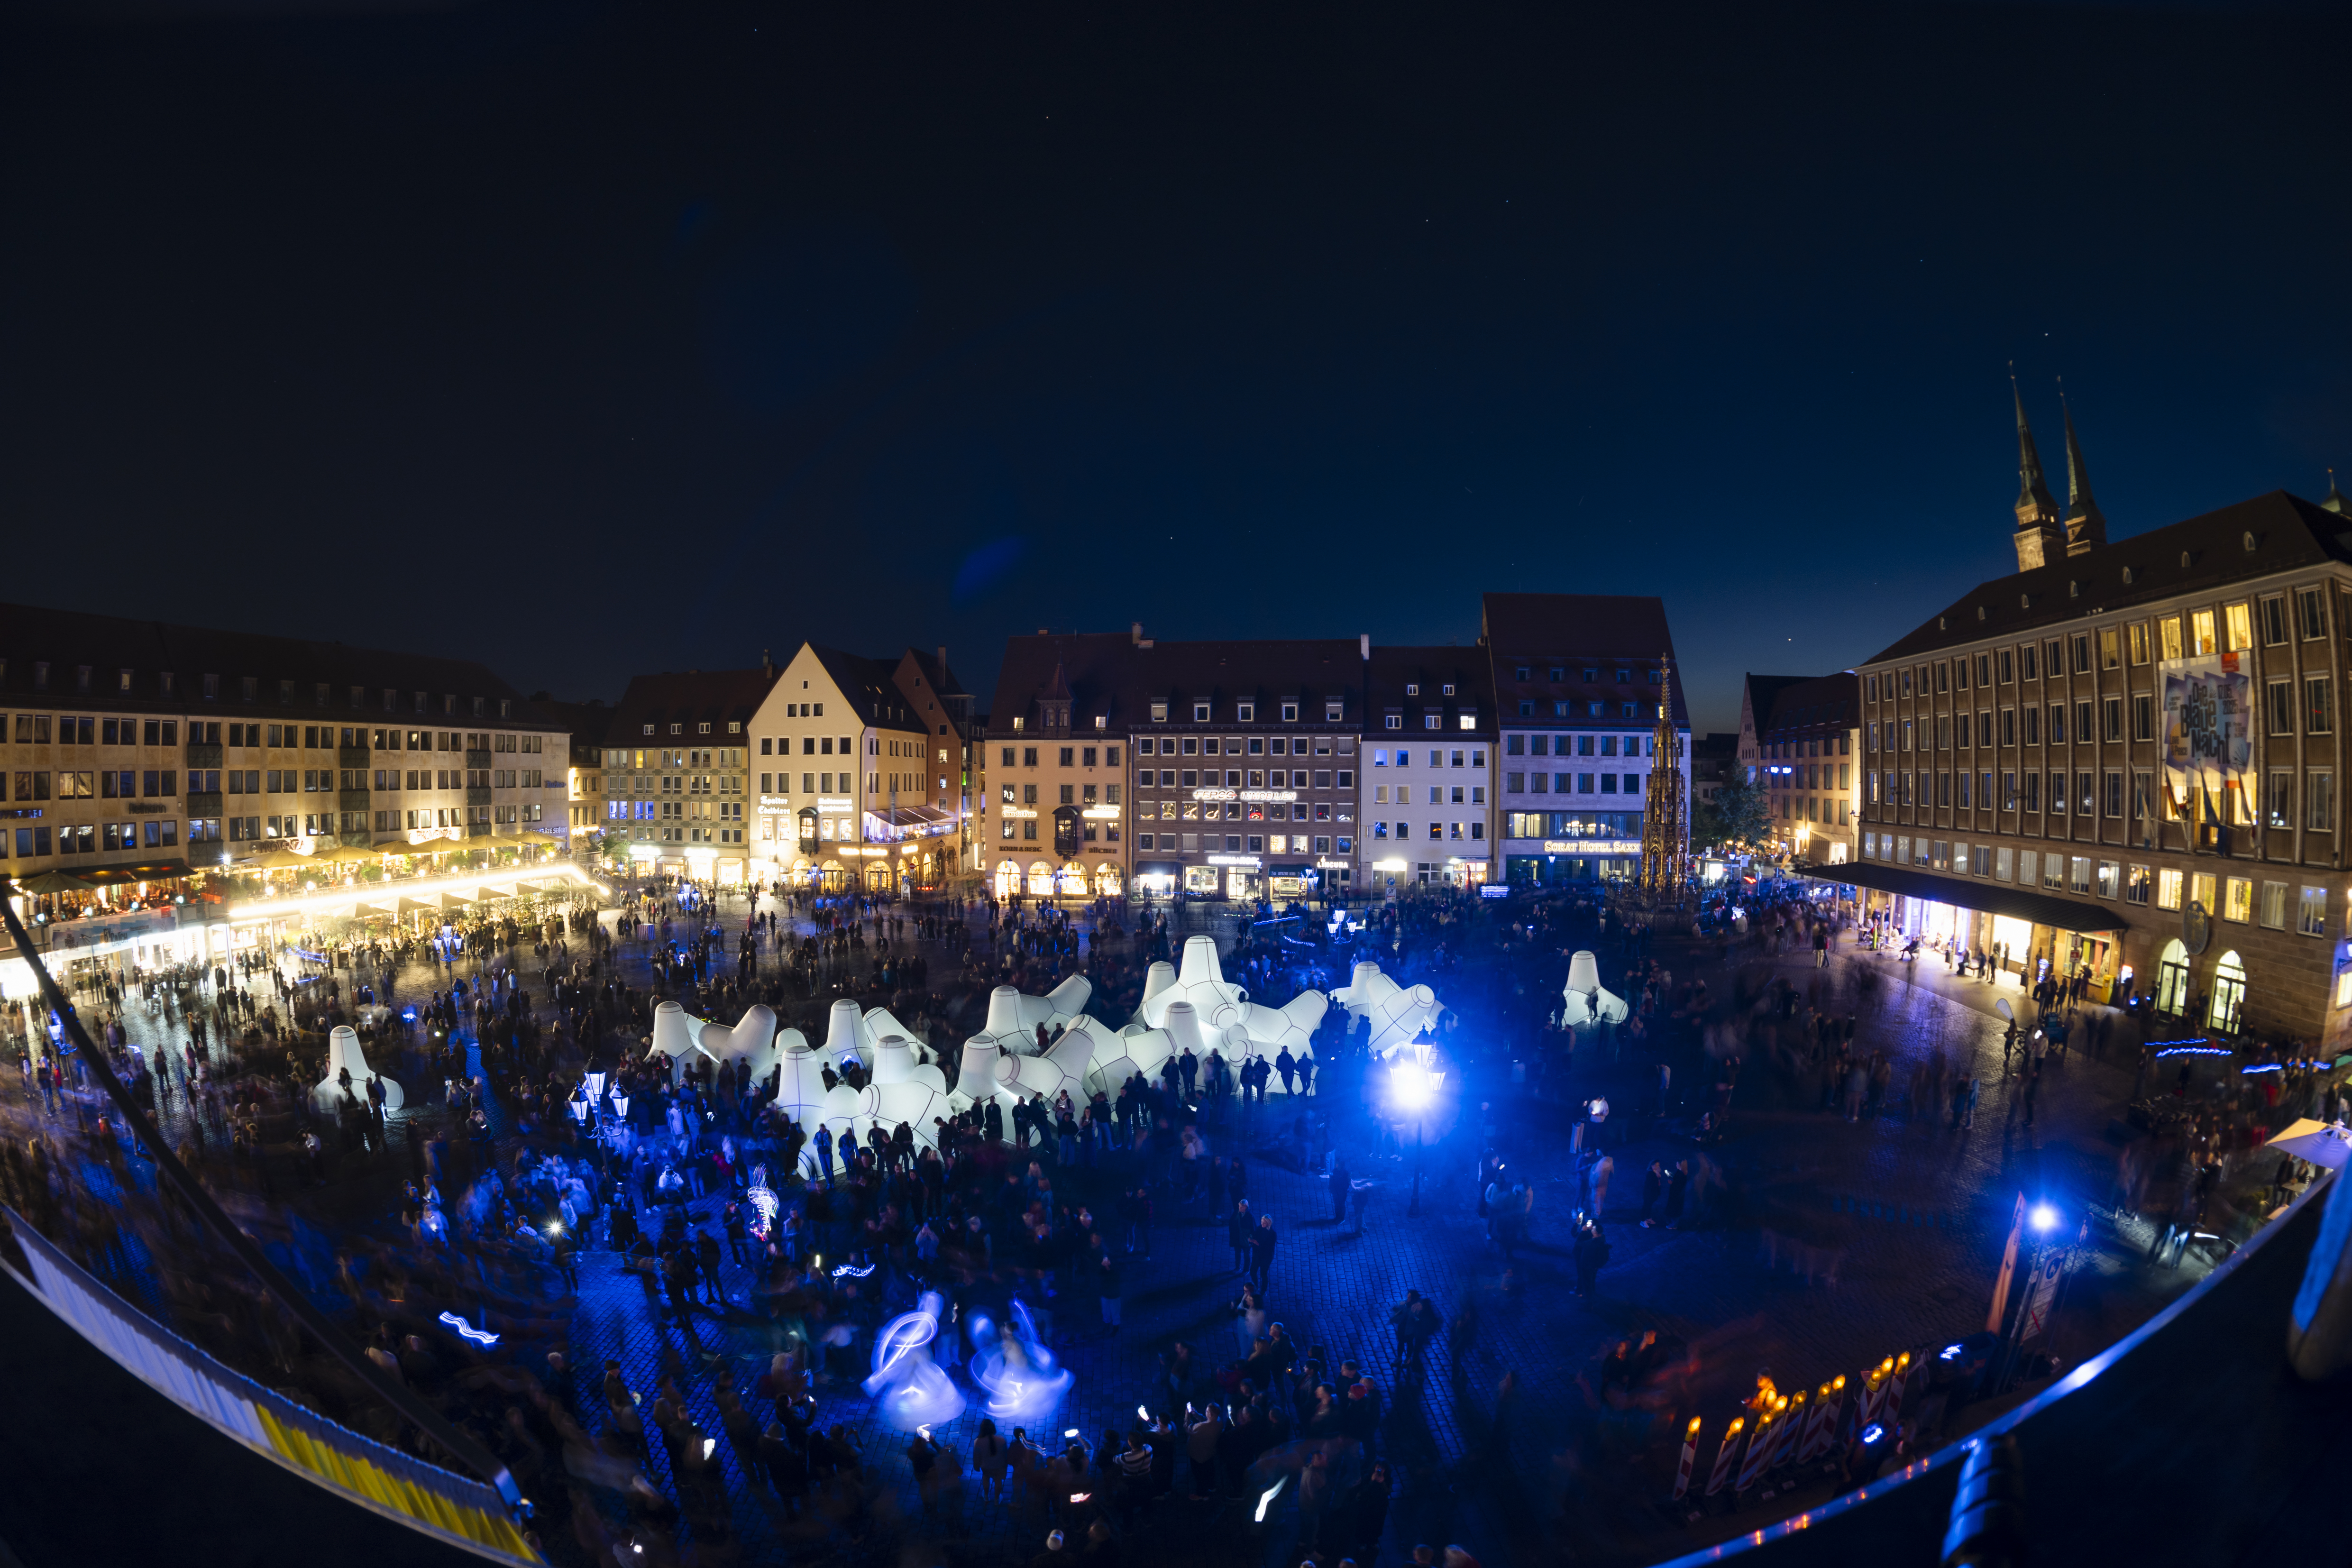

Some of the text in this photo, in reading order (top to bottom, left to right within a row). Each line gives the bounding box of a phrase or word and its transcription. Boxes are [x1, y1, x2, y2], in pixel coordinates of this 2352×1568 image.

[2193, 682, 2208, 706] Die
[2180, 695, 2216, 737] Blaue
[760, 795, 788, 805] Spalter
[1241, 791, 1296, 800] IMMOBILIEN
[758, 805, 791, 814] Edelbiere
